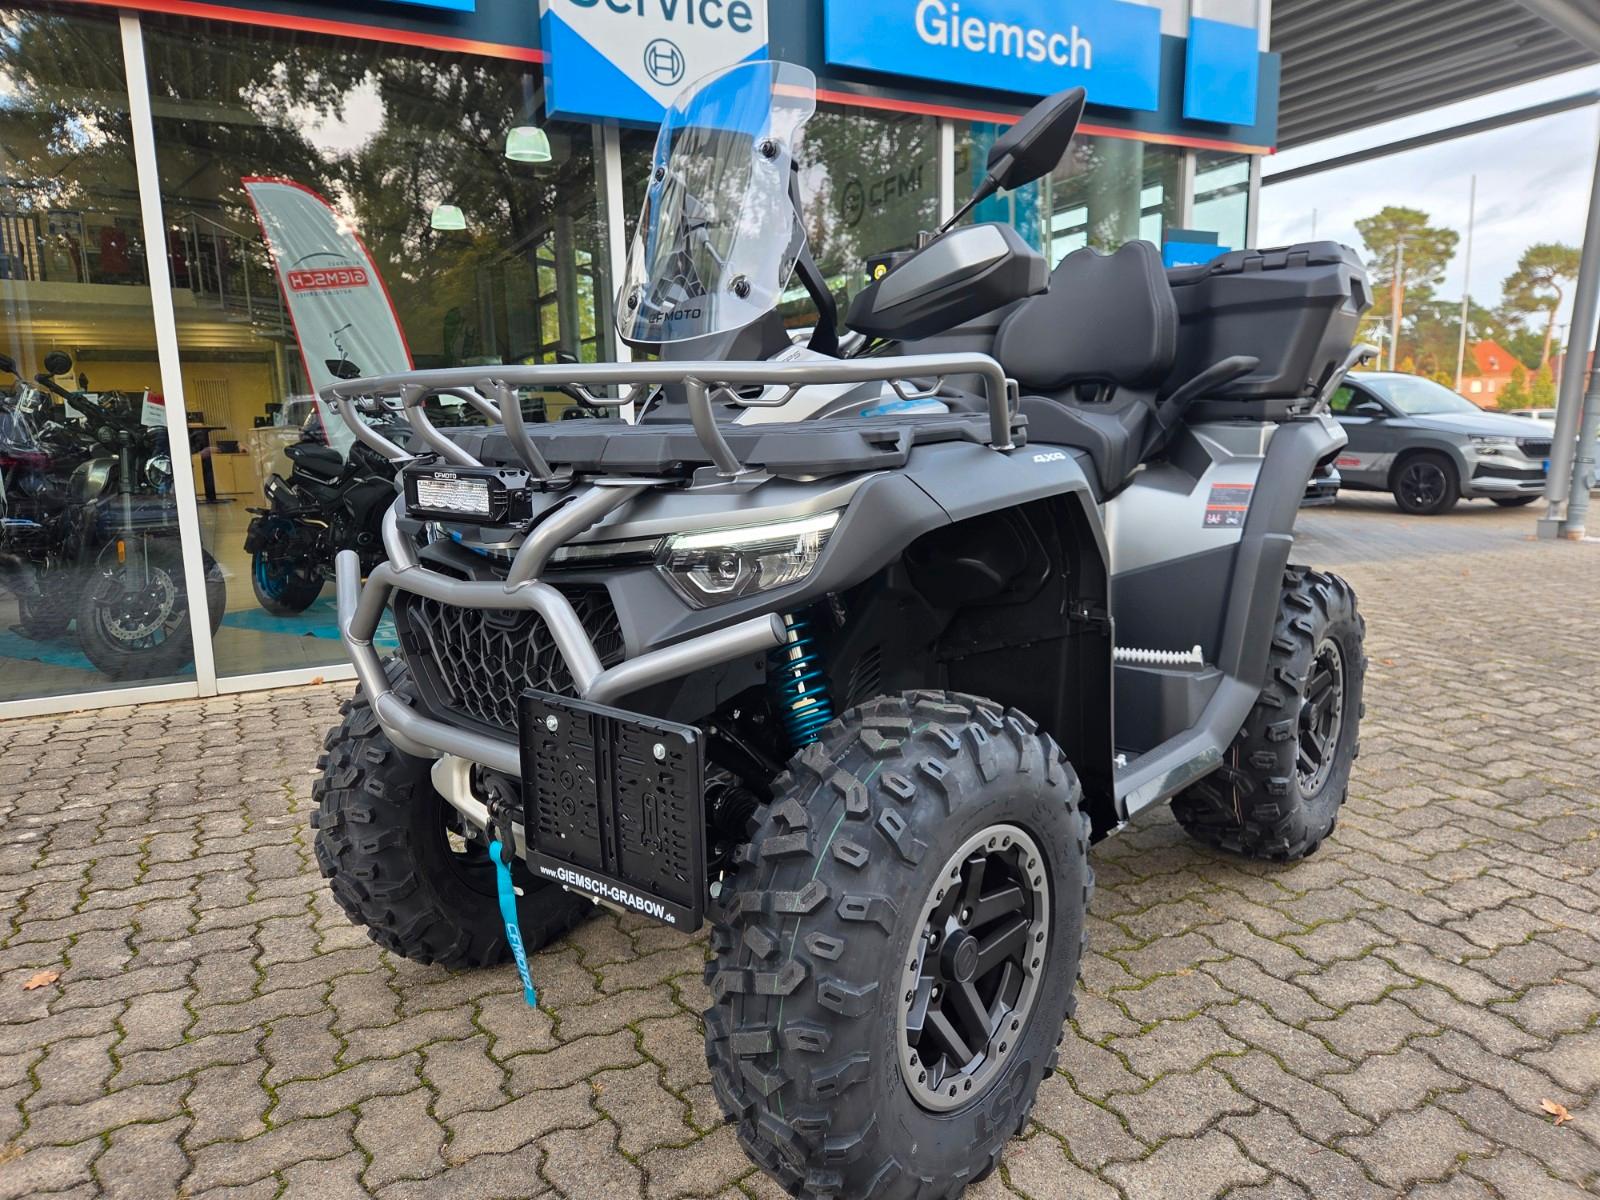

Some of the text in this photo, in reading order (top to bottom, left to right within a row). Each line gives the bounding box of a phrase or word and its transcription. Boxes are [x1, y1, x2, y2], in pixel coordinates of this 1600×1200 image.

[568, 0, 753, 33] rvice
[915, 0, 1092, 70] Giemsch
[540, 866, 676, 924] www.GIEMSCH-GRABOW.de
